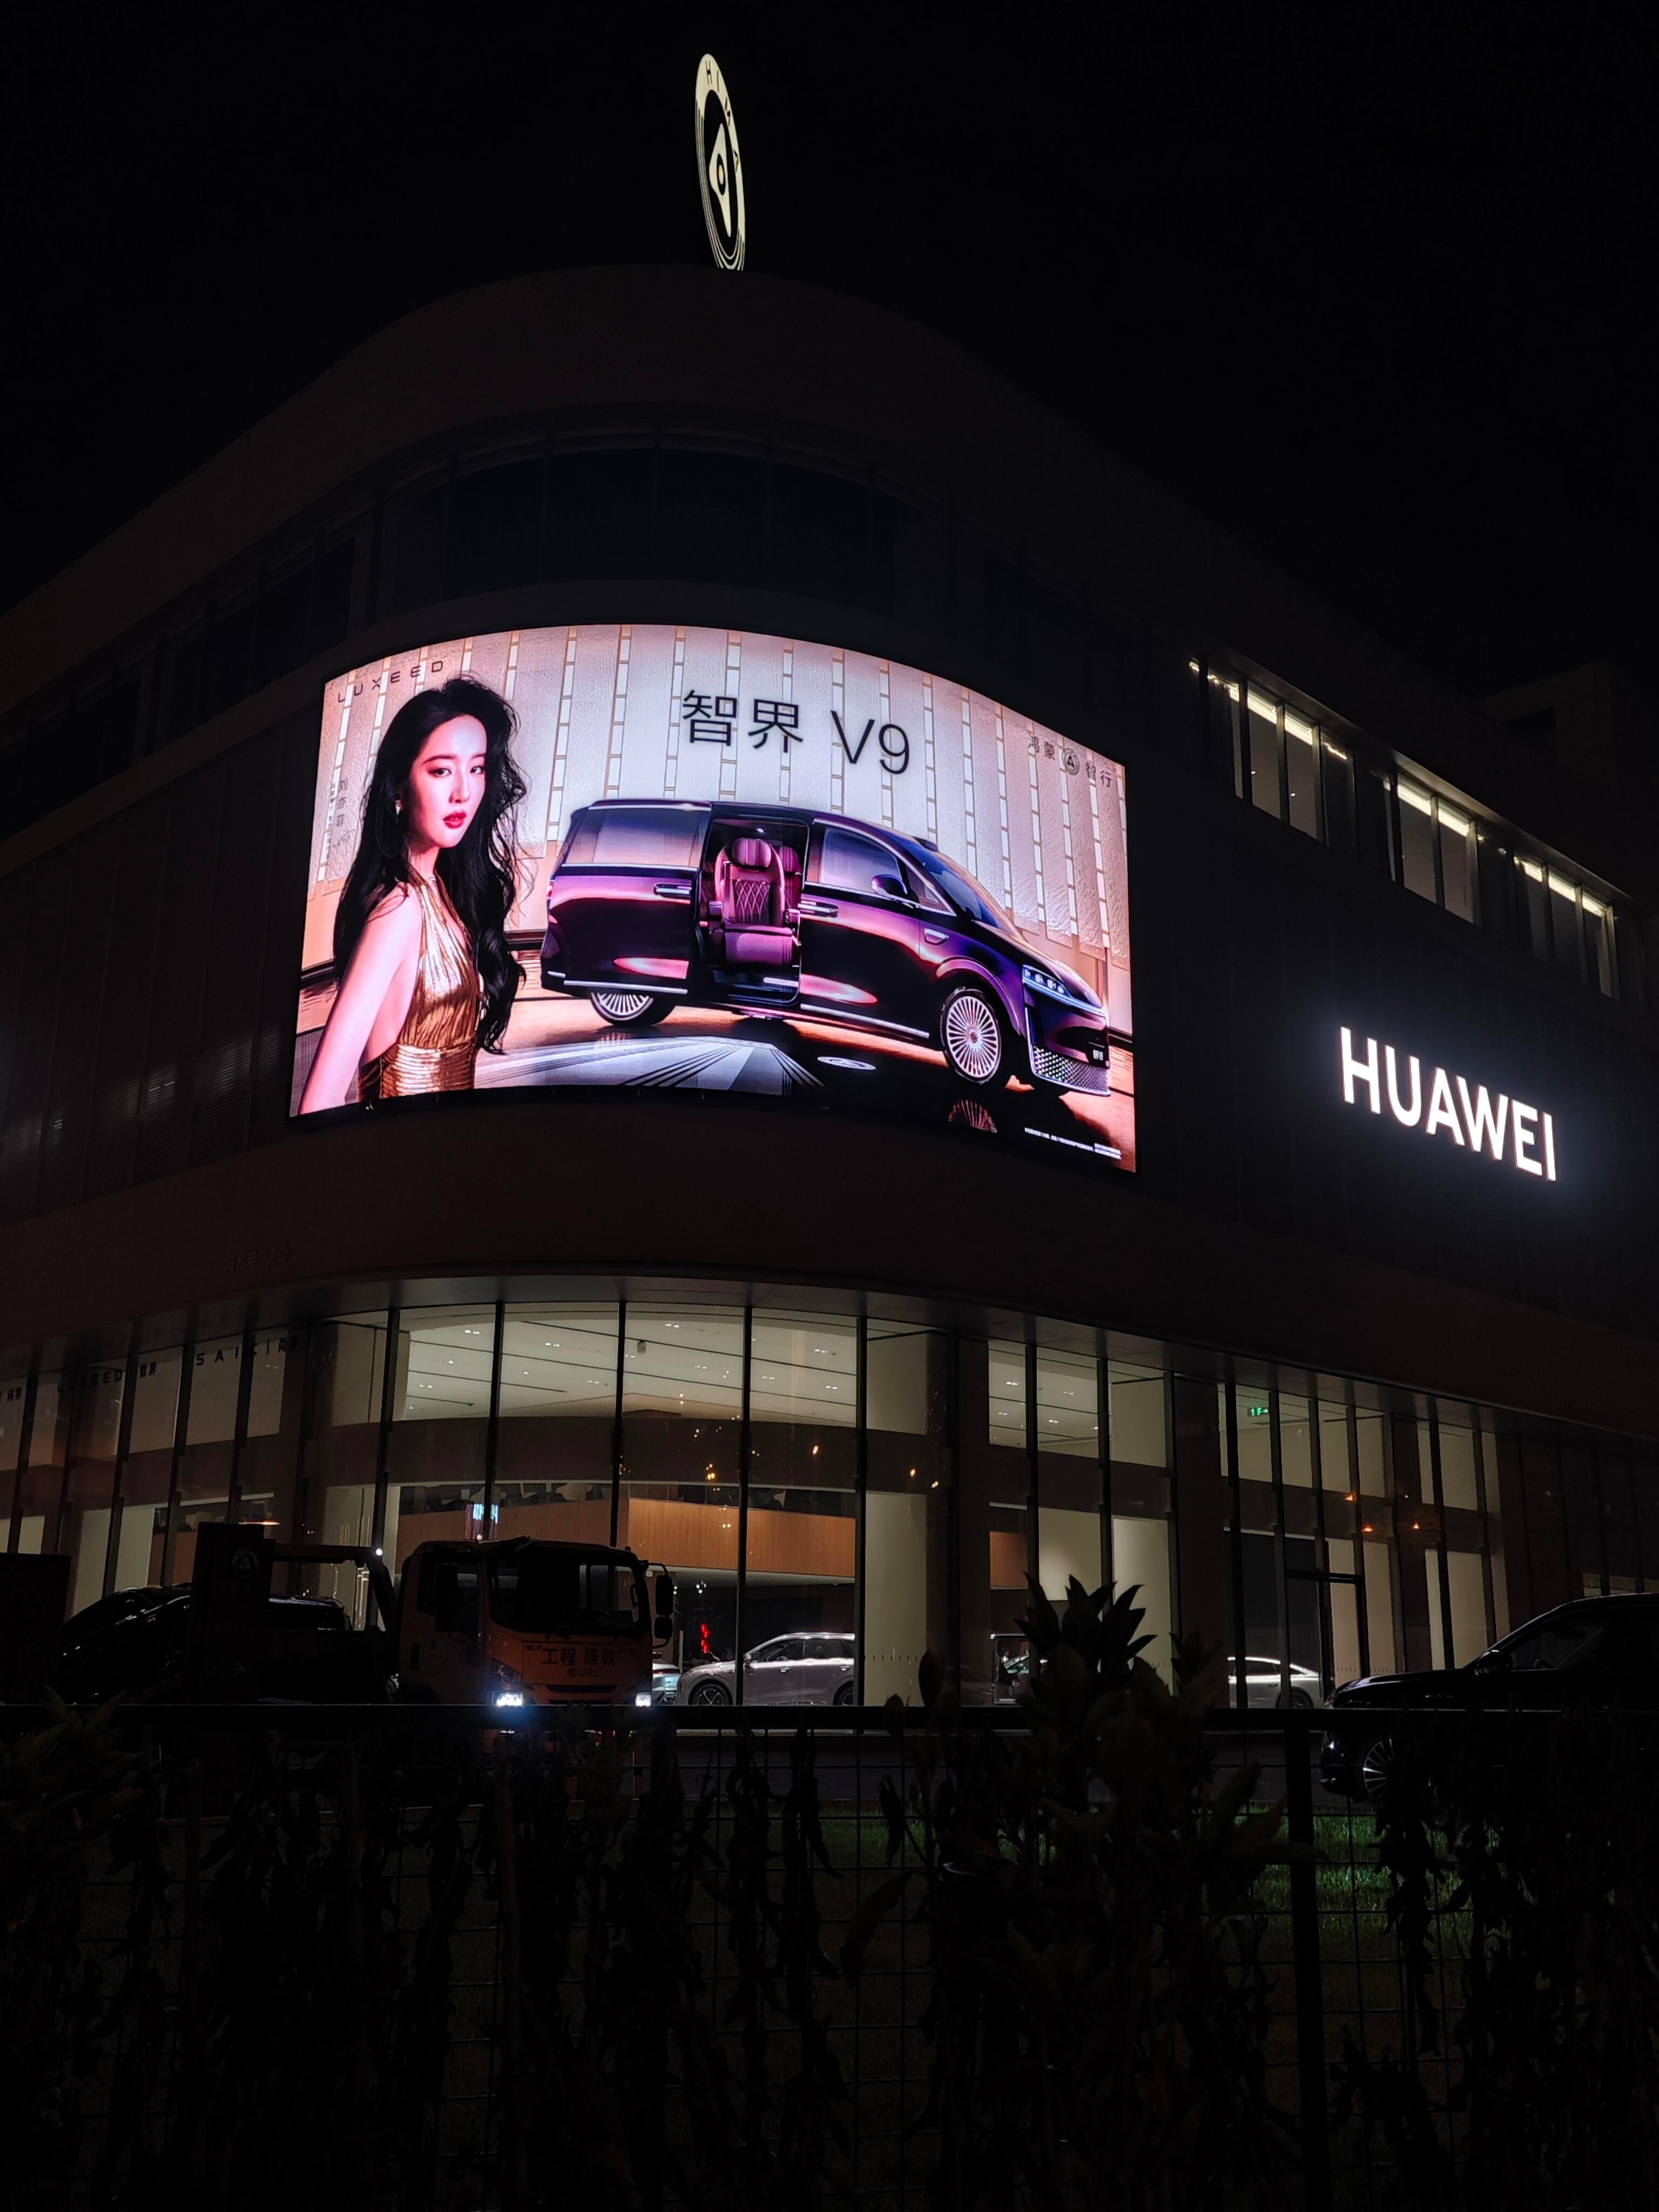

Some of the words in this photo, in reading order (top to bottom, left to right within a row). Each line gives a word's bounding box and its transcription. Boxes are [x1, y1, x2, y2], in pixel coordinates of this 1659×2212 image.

[704, 60, 740, 172] HIMA
[338, 660, 443, 703] LUXEED
[682, 689, 804, 753] 智界
[830, 709, 910, 775] V9
[1085, 761, 1112, 787] 智行
[335, 776, 349, 827] 刘亦菲
[1339, 1025, 1557, 1182] HUAWEI
[541, 1648, 577, 1667] 工程
